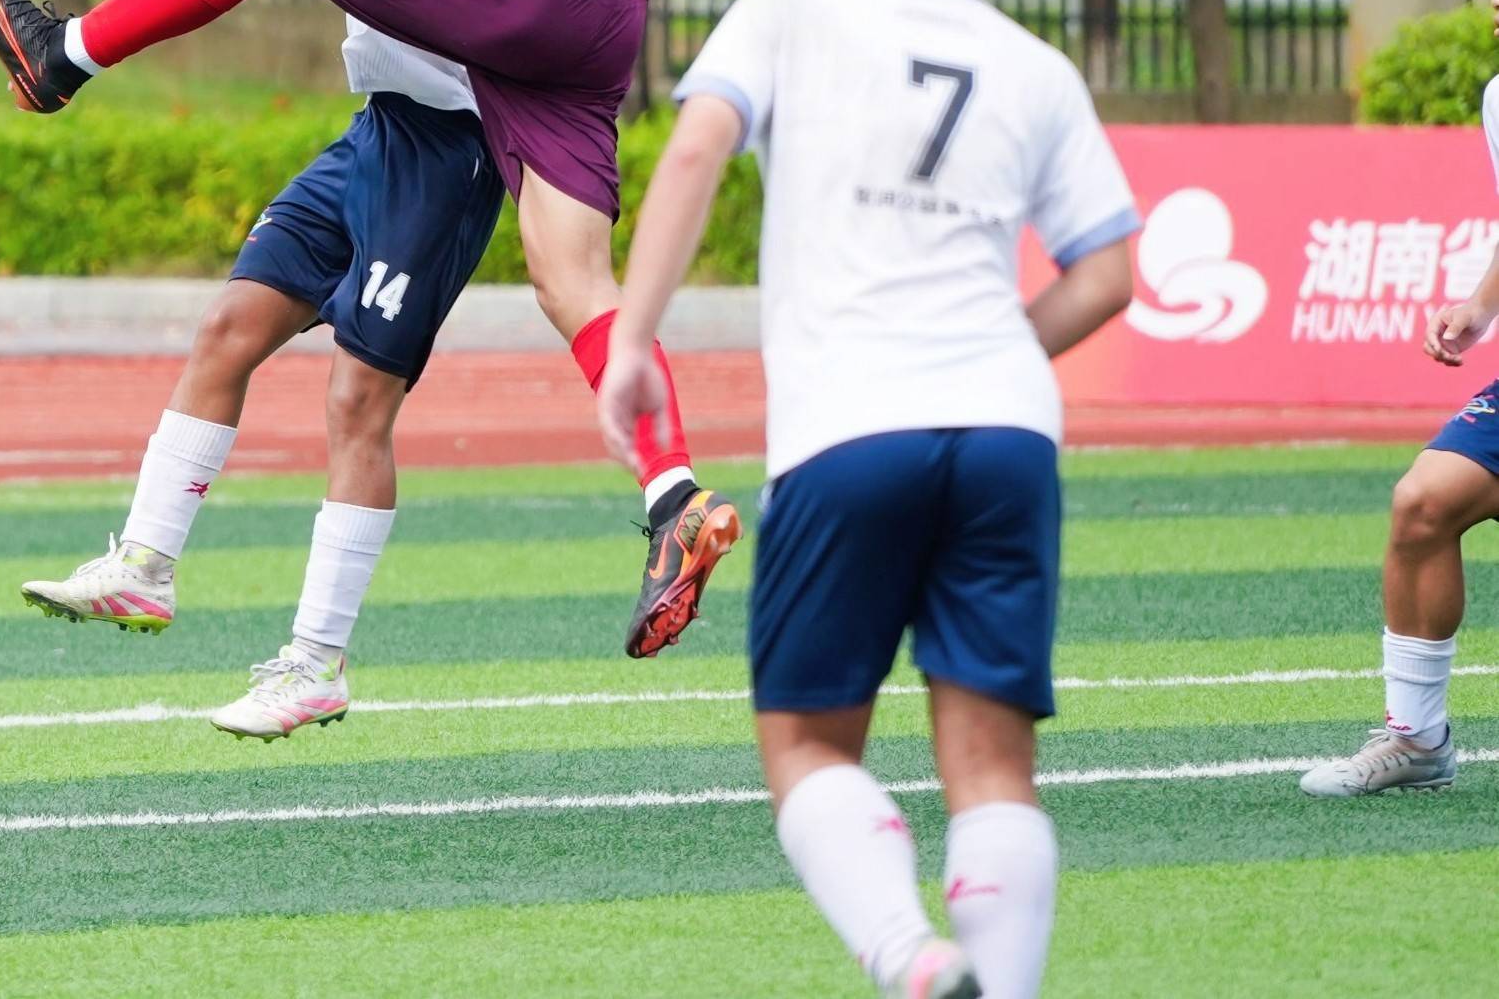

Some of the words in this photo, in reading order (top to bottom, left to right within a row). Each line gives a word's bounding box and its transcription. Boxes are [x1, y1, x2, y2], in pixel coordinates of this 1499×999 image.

[908, 56, 977, 181] 7
[361, 261, 411, 321] 14
[1299, 217, 1499, 302] 湖南省
[1291, 302, 1415, 342] HUNAN
